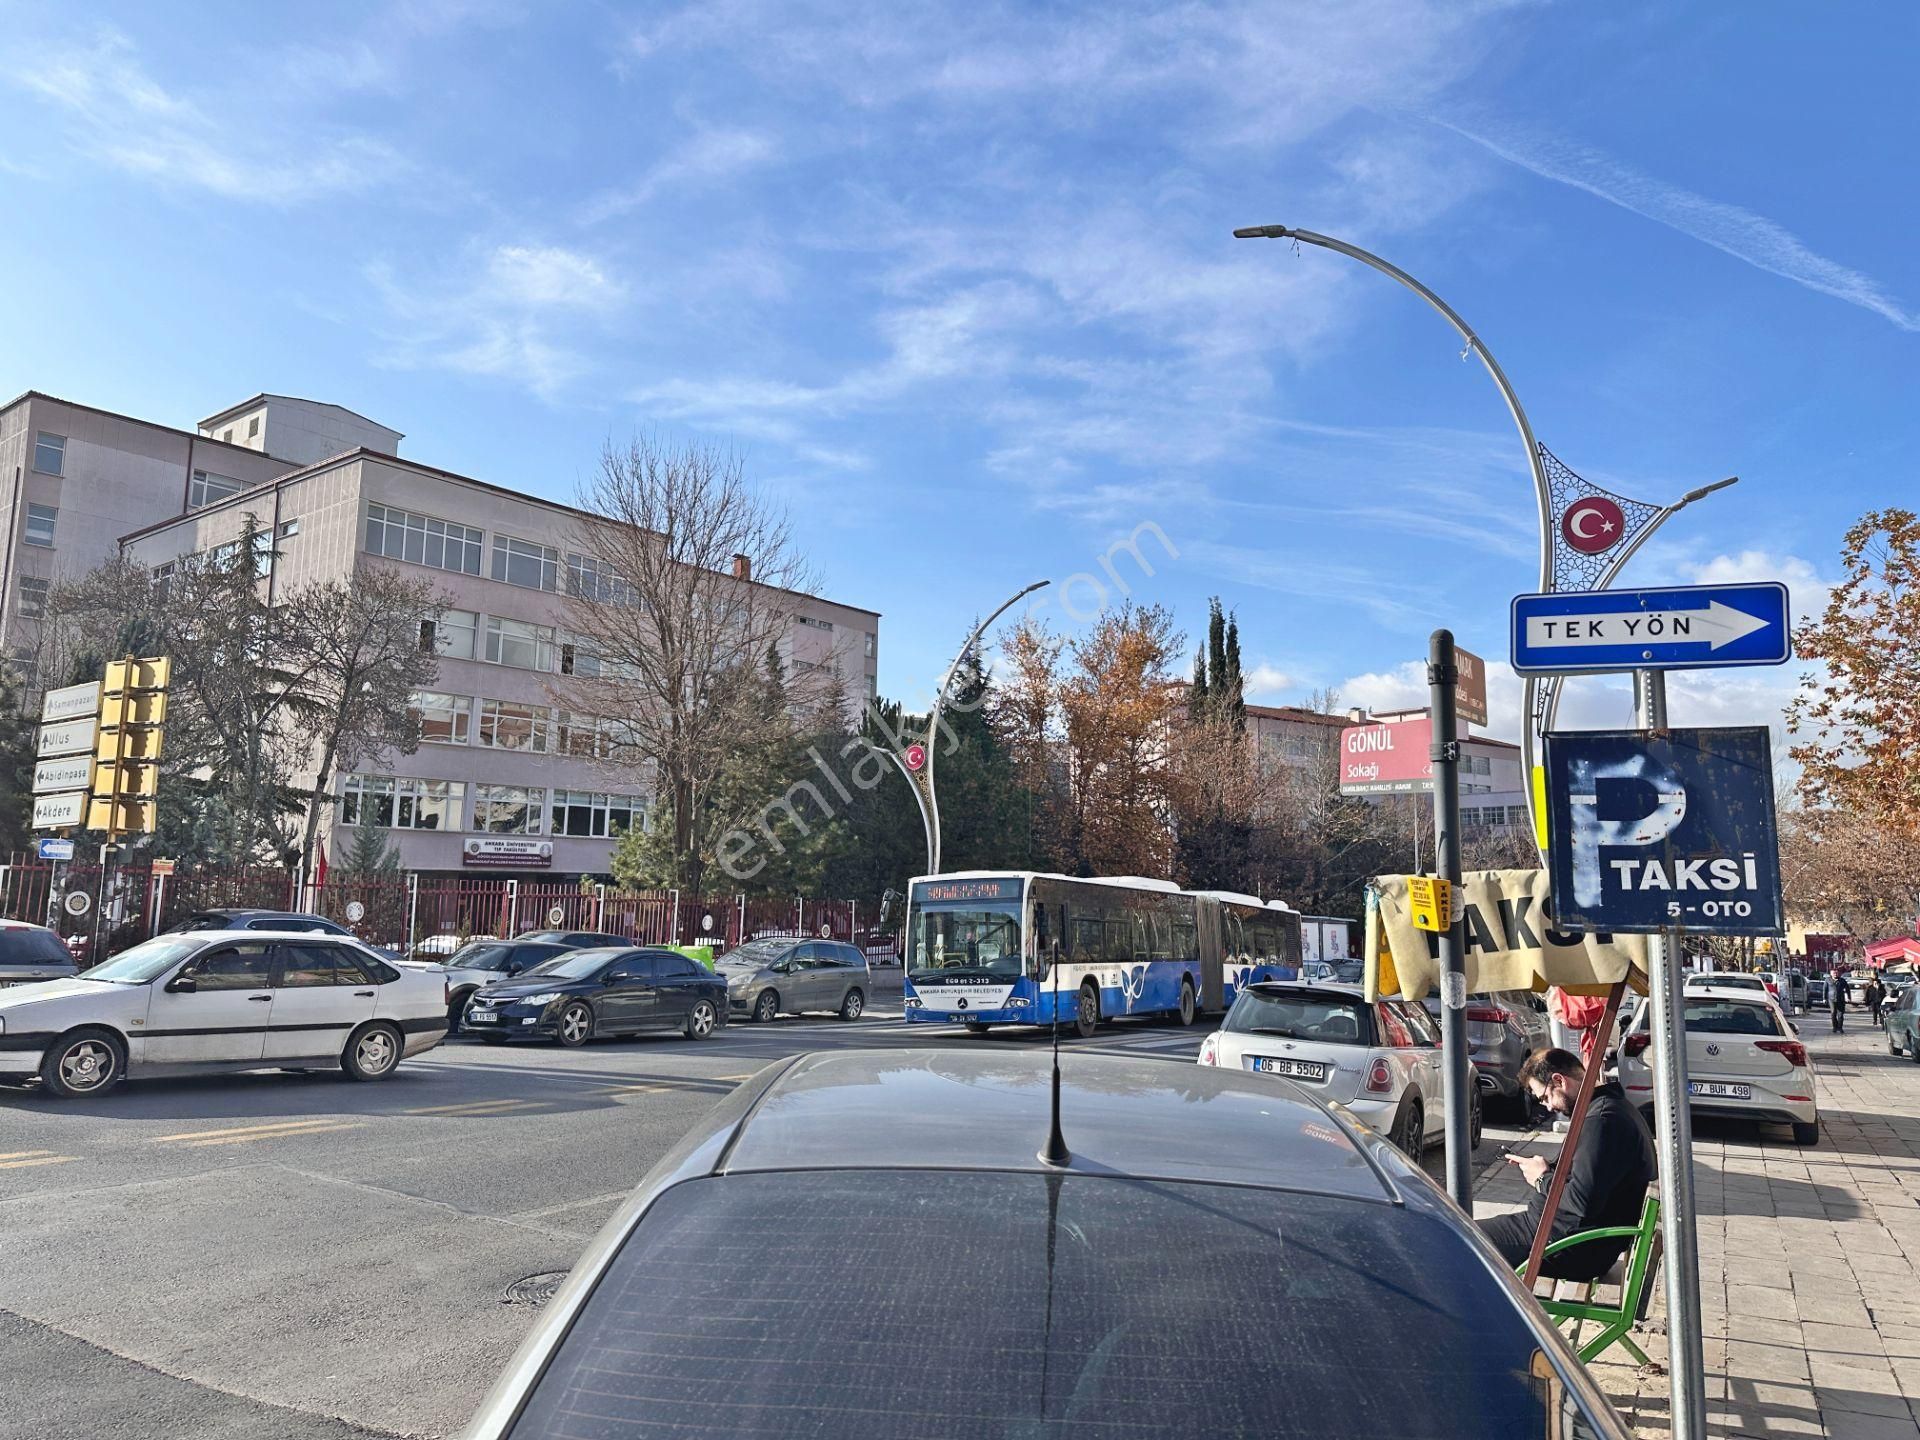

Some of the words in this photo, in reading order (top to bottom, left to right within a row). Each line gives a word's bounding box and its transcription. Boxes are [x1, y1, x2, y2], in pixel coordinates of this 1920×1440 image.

[1543, 620, 1604, 639] TEK
[1623, 614, 1690, 636] YÖN
[49, 732, 70, 746] Ulus
[1347, 724, 1394, 753] GÖNÜL
[44, 767, 87, 781] Abidinpaşa
[1347, 761, 1379, 780] Sokağı
[42, 805, 71, 818] Akdere
[1567, 754, 1687, 908] P
[1610, 852, 1757, 891] TAKSİ
[1666, 901, 1681, 917] 5
[1702, 901, 1751, 917] OTO
[1261, 1058, 1273, 1072] 06
[1279, 1060, 1292, 1073] BB
[1296, 1063, 1322, 1077] 5502
[1692, 1083, 1704, 1093] 07
[1709, 1084, 1727, 1094] BUH
[1732, 1085, 1749, 1096] 498
